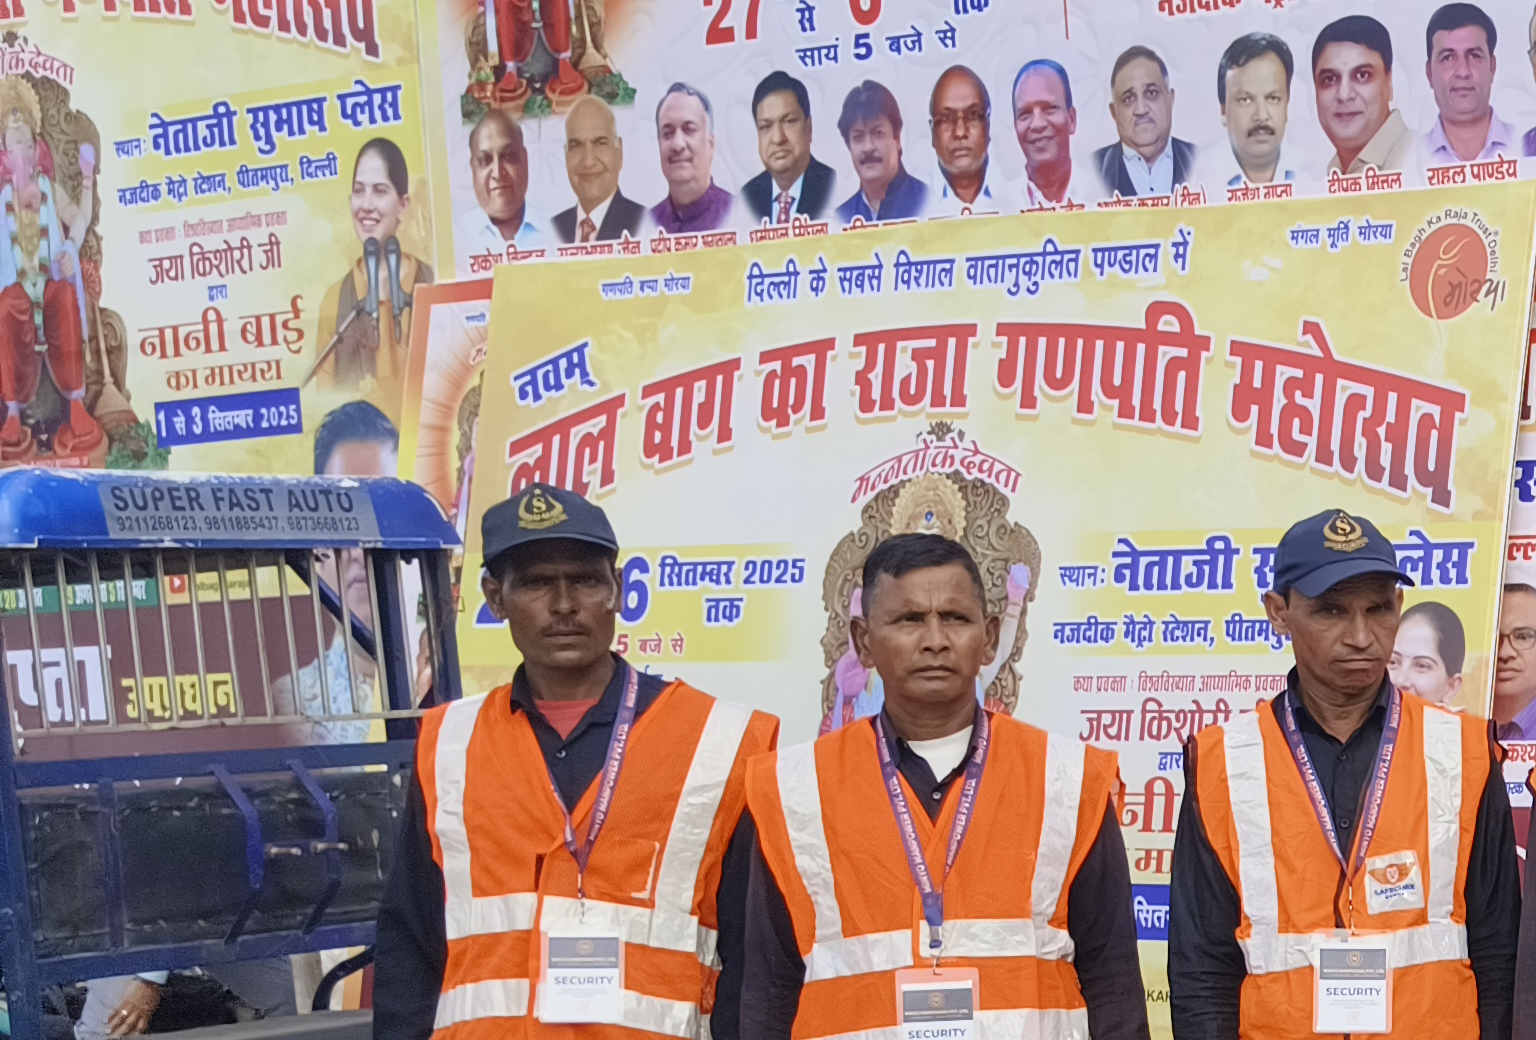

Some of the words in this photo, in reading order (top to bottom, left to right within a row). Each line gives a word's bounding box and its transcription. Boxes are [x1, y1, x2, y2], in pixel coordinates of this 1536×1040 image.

[796, 40, 838, 68] सायं
[853, 33, 873, 62] 5
[886, 25, 923, 55] बजे
[936, 20, 956, 48] से
[149, 101, 237, 156] नेताजी
[247, 96, 327, 154] सुभाष
[337, 79, 402, 127] प्लेस
[117, 180, 161, 206] नजदीक
[299, 152, 338, 180] दिल्ली
[1470, 154, 1518, 184] पाण्डेय
[1289, 222, 1320, 246] मंगल
[1327, 219, 1351, 249] मूर्ति
[1357, 218, 1394, 242] मोरया
[1403, 226, 1427, 259] Bagh
[1427, 213, 1442, 229] Ka
[1444, 208, 1469, 223] Raja
[1470, 211, 1494, 241] Trust
[1487, 240, 1500, 274] Delhi
[149, 254, 184, 285] जया
[190, 236, 253, 279] किशोरी
[259, 233, 282, 270] जी
[747, 258, 800, 302] दिल्ली
[810, 255, 826, 296] के
[837, 253, 883, 295] सबसे
[894, 250, 955, 292] विशाल
[966, 239, 1081, 296] वातानुकुलित
[1092, 243, 1162, 278] पण्डाल
[1172, 230, 1193, 271] में
[602, 276, 633, 297] गणपति
[665, 272, 691, 293] मोरया
[138, 307, 228, 360] नानी
[239, 295, 305, 354] बाई
[165, 369, 198, 391] का
[204, 359, 283, 387] मायरा
[513, 341, 597, 403] नवम्
[173, 409, 185, 435] से
[192, 406, 203, 434] 3
[208, 407, 254, 432] सितम्बर
[261, 405, 298, 427] 2025
[640, 357, 742, 460] बाग
[758, 337, 836, 430] का
[853, 323, 978, 412] राजा
[996, 301, 1211, 431] गणपति
[1230, 320, 1467, 510] महोत्सव
[111, 485, 205, 512] SUPER
[212, 487, 275, 513] FAST
[287, 489, 354, 513] AUTO
[659, 555, 736, 588] सितम्बर
[743, 558, 806, 585] 2025
[1112, 535, 1240, 591] नेताजी
[705, 597, 744, 624] तक
[638, 632, 662, 654] बजे
[671, 632, 685, 654] से
[1053, 616, 1117, 645] नजदीक
[1096, 675, 1128, 694] प्रवक्ता
[1255, 673, 1288, 693] प्रवक्ता
[1079, 709, 1135, 742] जया
[554, 975, 614, 988] SECURITY
[1325, 986, 1382, 998] SECURITY
[907, 1026, 967, 1040] SECURITY
